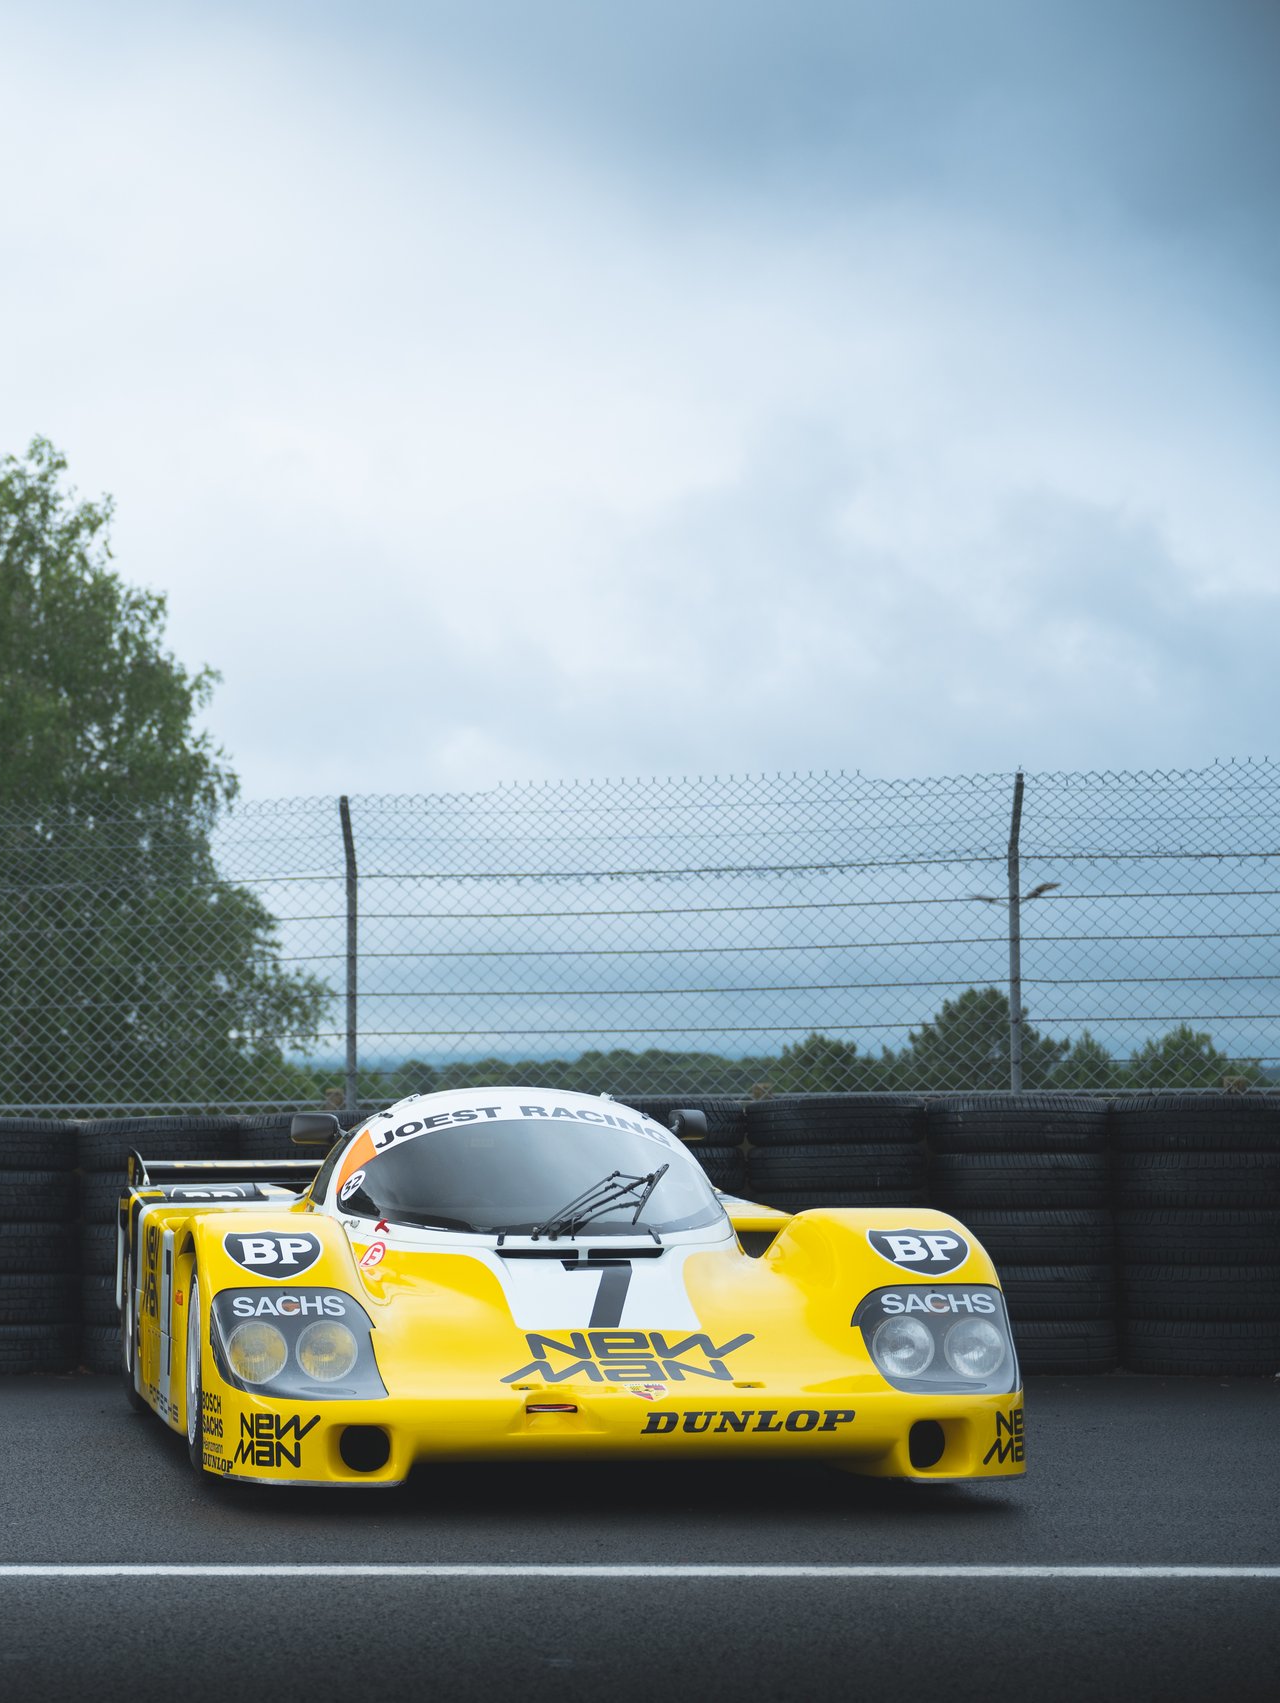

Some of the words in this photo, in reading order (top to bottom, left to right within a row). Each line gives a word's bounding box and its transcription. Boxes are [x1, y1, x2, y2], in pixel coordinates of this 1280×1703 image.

[375, 1106, 502, 1149] JOEST
[520, 1105, 671, 1147] RACING
[342, 1175, 362, 1198] 32
[237, 1238, 313, 1265] BP
[881, 1235, 959, 1262] BP
[232, 1295, 346, 1317] SACHS
[560, 1260, 633, 1328] 7
[880, 1293, 996, 1314] SACHS
[202, 1390, 222, 1415] BOSCH
[202, 1414, 224, 1439] SACHS
[640, 1409, 856, 1435] DUNLOP
[203, 1452, 234, 1473] DUNLOP
